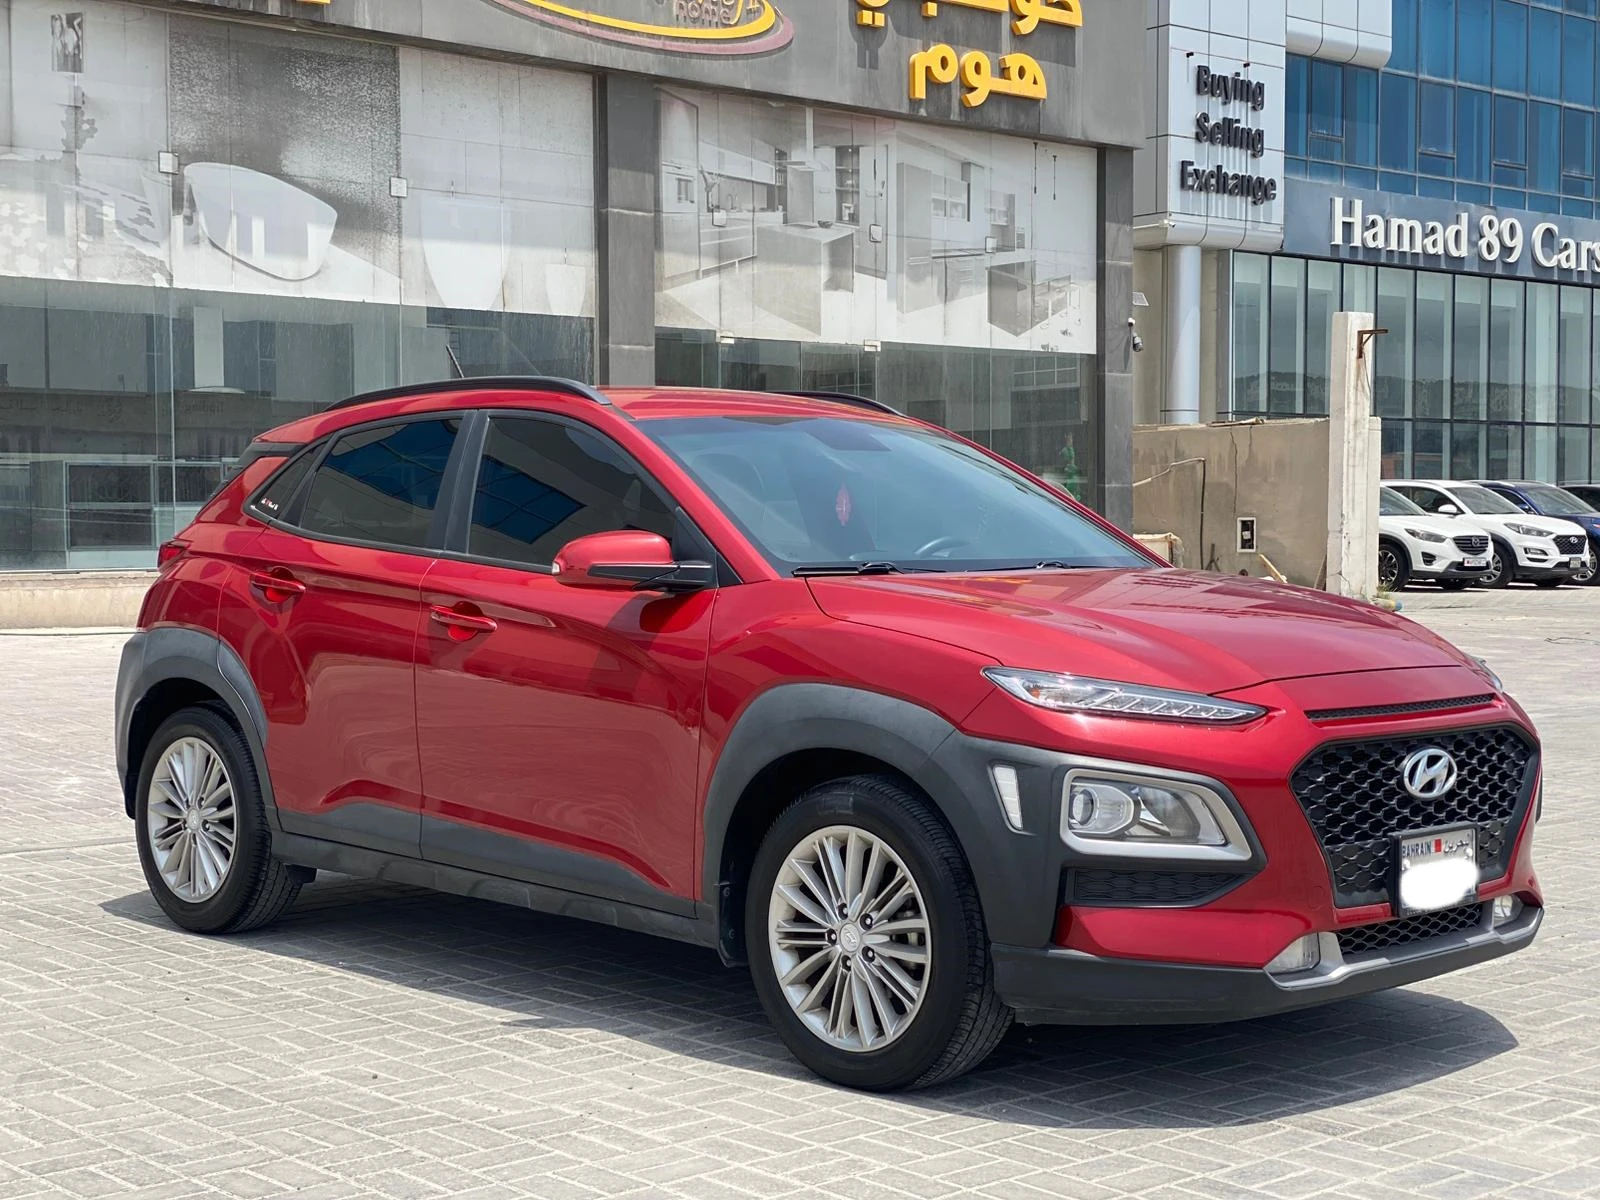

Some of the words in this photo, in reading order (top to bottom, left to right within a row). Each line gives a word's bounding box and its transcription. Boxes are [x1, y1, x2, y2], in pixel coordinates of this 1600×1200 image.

[909, 43, 1047, 108] هوم
[1196, 65, 1265, 111] Buying
[1195, 112, 1265, 158] Selling
[1180, 160, 1277, 206] Exchange
[1330, 197, 1469, 258] Hamad
[1478, 214, 1524, 263] 89
[1402, 841, 1432, 857] BAHRAIN
